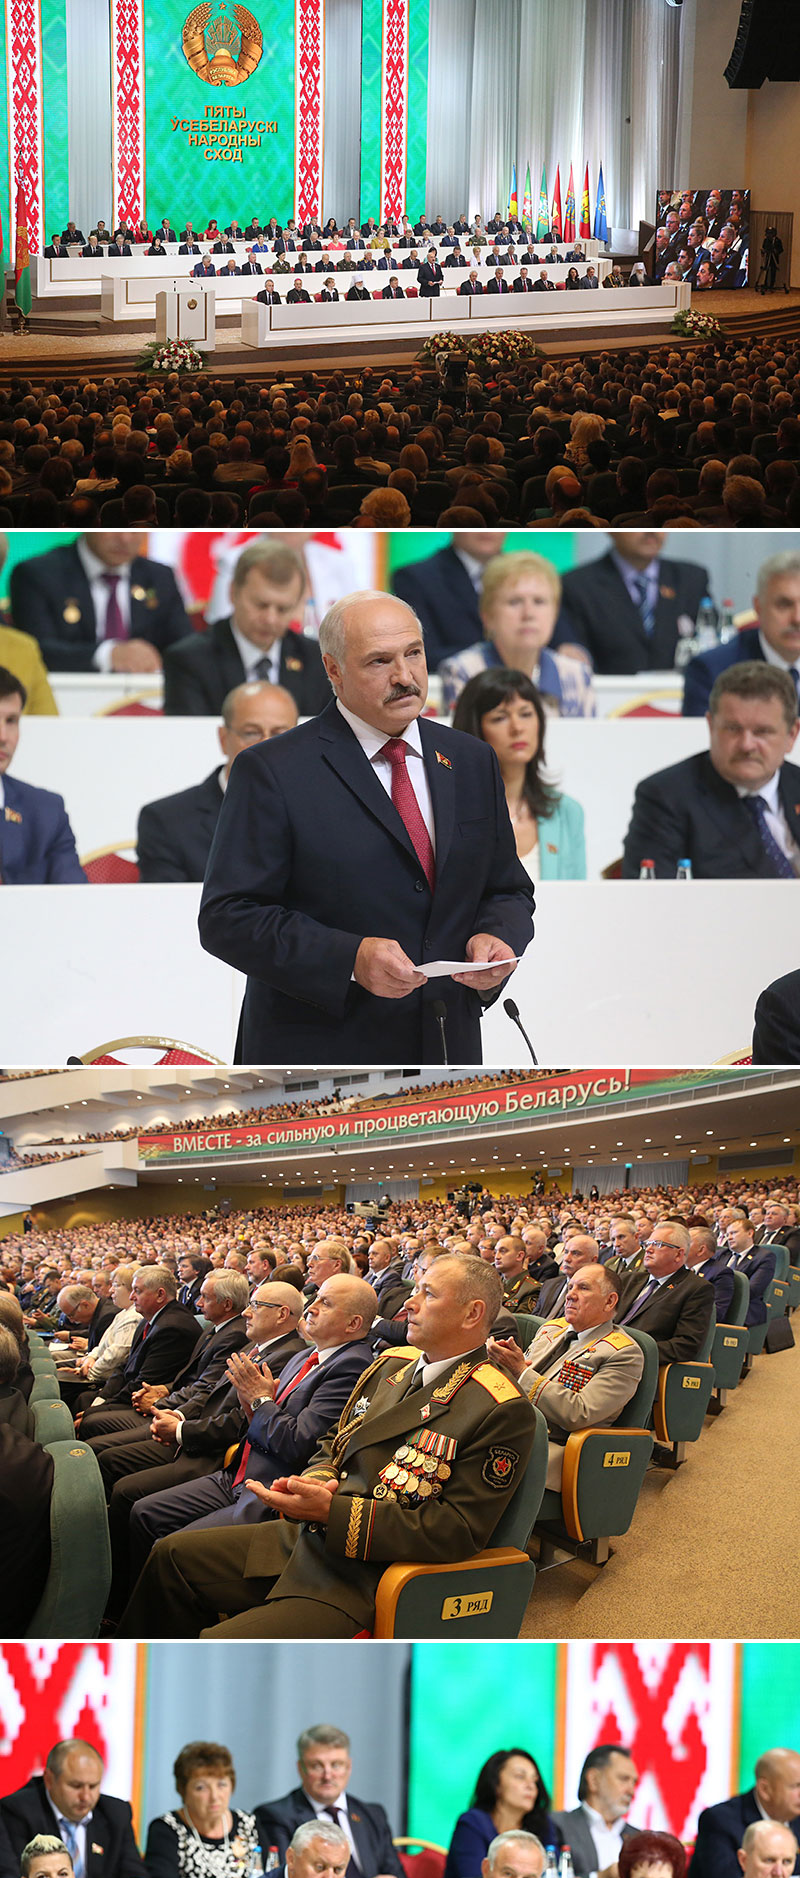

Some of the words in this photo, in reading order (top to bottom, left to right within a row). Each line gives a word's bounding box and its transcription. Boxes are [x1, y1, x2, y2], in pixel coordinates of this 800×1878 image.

[204, 105, 246, 118] ПЯТЫ
[170, 116, 278, 132] ЎСЕБЕЛАРУСКІ
[188, 134, 261, 148] НАРОДНЫ
[204, 148, 243, 162] СХОД
[173, 1133, 232, 1153] ВМЕСТЕ
[246, 1136, 262, 1148] за
[267, 1123, 336, 1144] сильную
[340, 1123, 350, 1136] и
[354, 1099, 500, 1138] процветающую
[505, 1069, 631, 1114] Беларусь!
[685, 1377, 690, 1387] 5
[608, 1454, 614, 1465] 4
[450, 1598, 462, 1618] 3
[466, 1598, 488, 1612] РЯД
